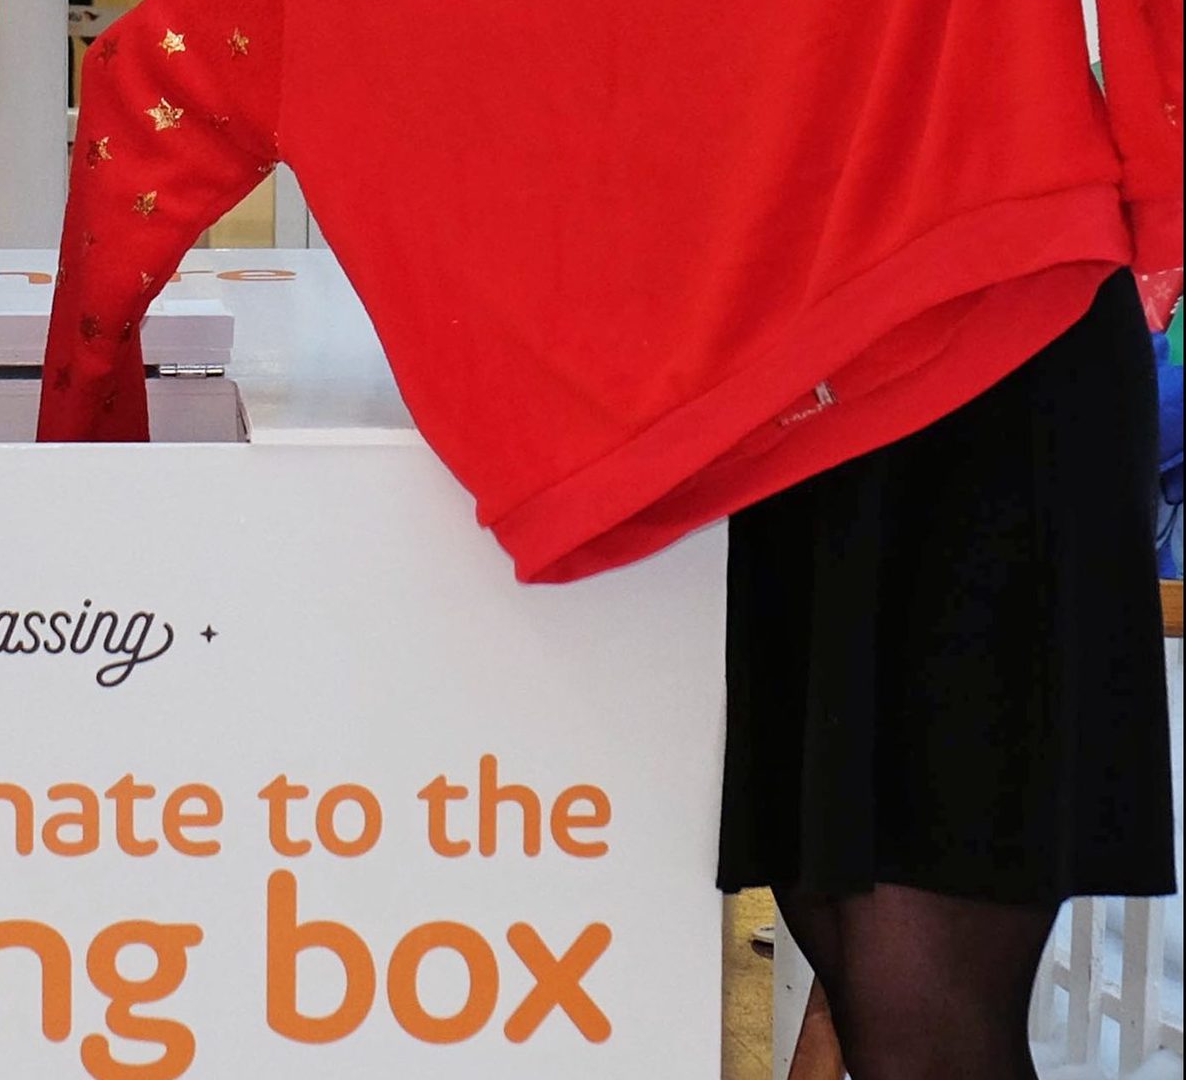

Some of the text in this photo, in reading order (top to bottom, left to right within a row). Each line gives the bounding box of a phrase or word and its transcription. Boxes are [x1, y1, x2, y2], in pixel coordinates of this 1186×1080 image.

[258, 775, 383, 858] to
[417, 753, 612, 858] the
[266, 868, 613, 1044] box
